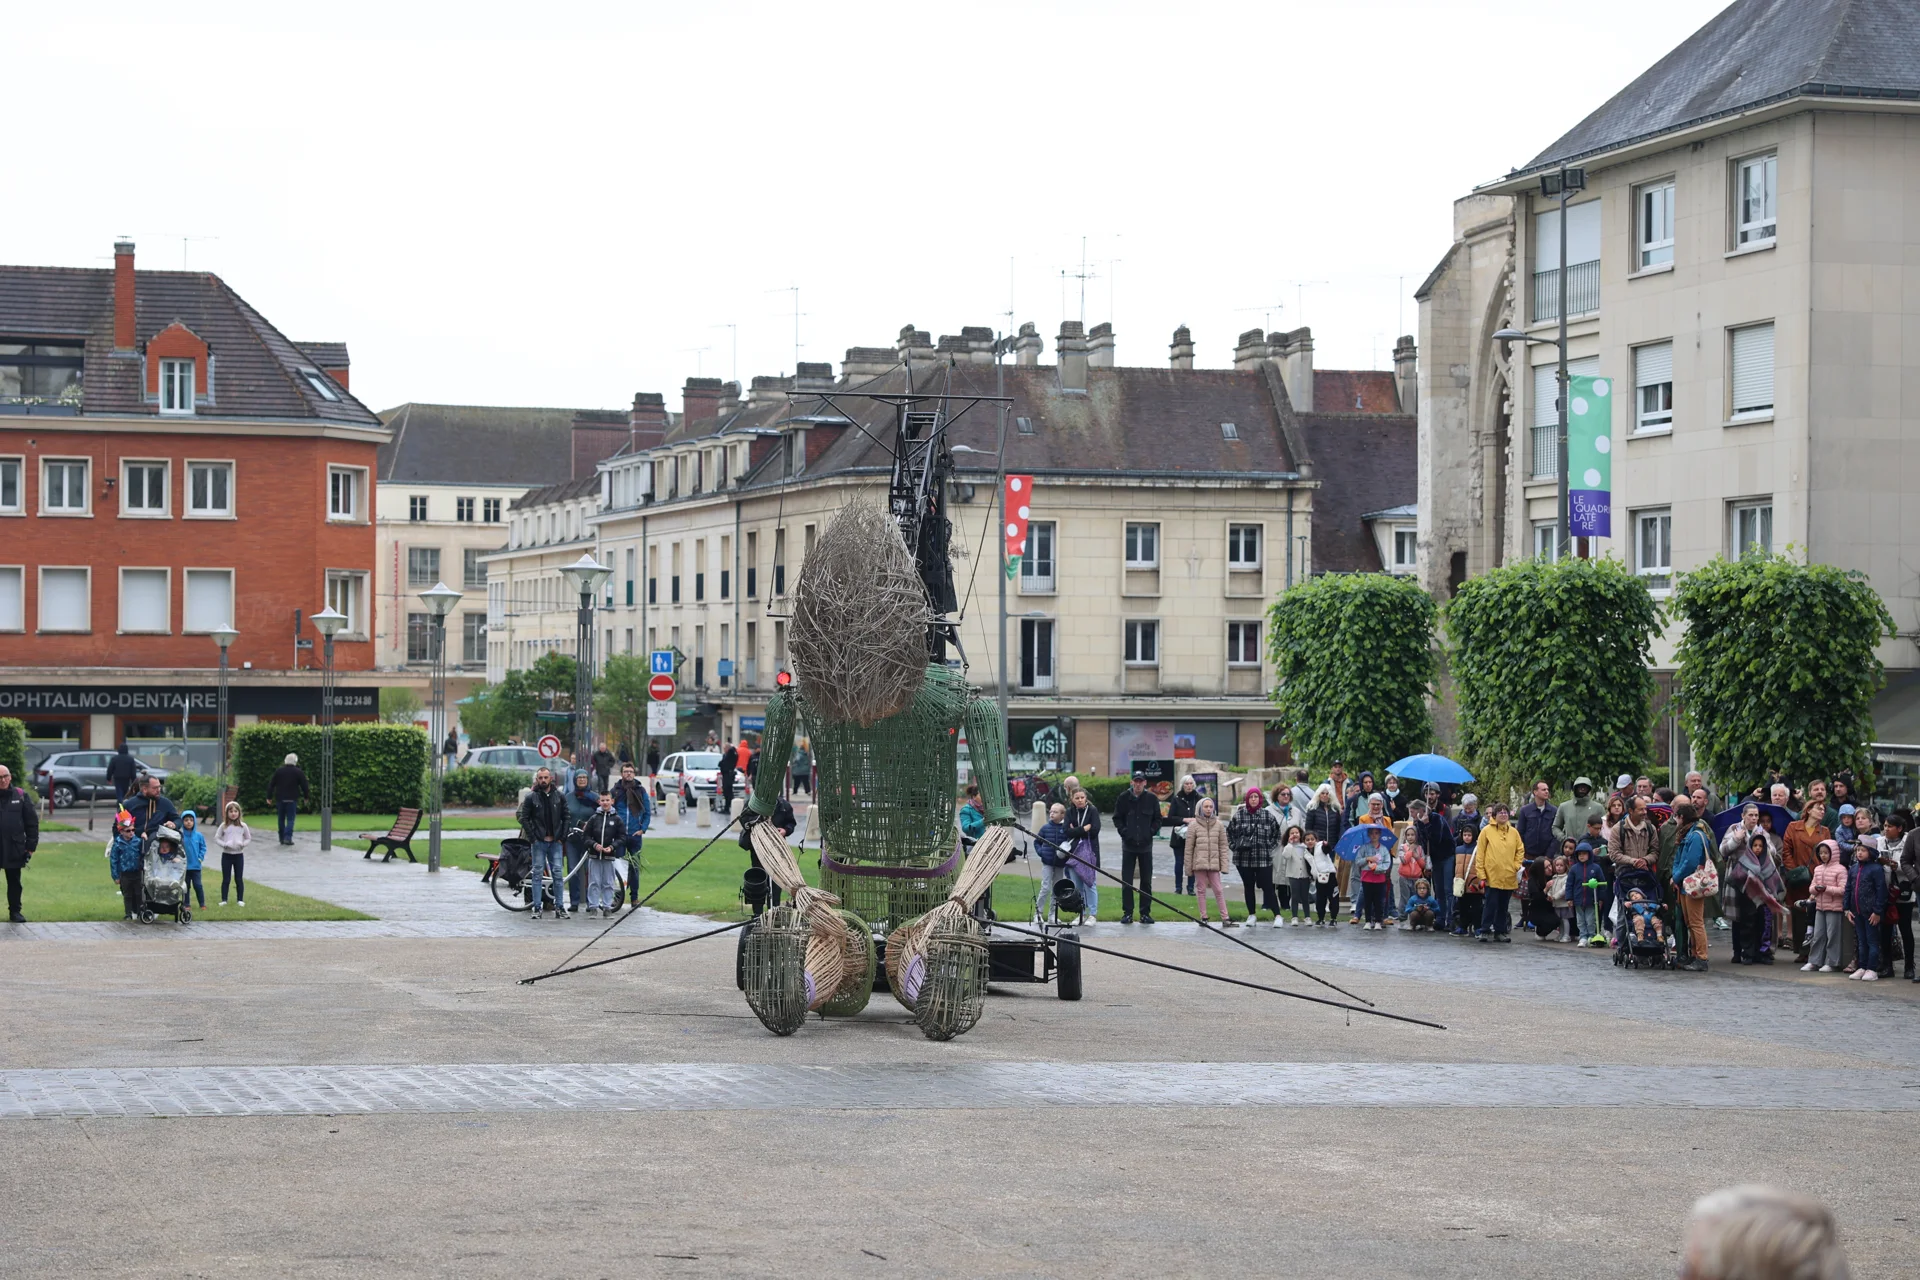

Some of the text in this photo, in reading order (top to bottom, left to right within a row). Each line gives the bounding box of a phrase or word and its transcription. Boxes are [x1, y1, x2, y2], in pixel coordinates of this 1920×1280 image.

[1573, 495, 1584, 504] LE
[1582, 521, 1594, 530] RE
[354, 696, 362, 705] 24
